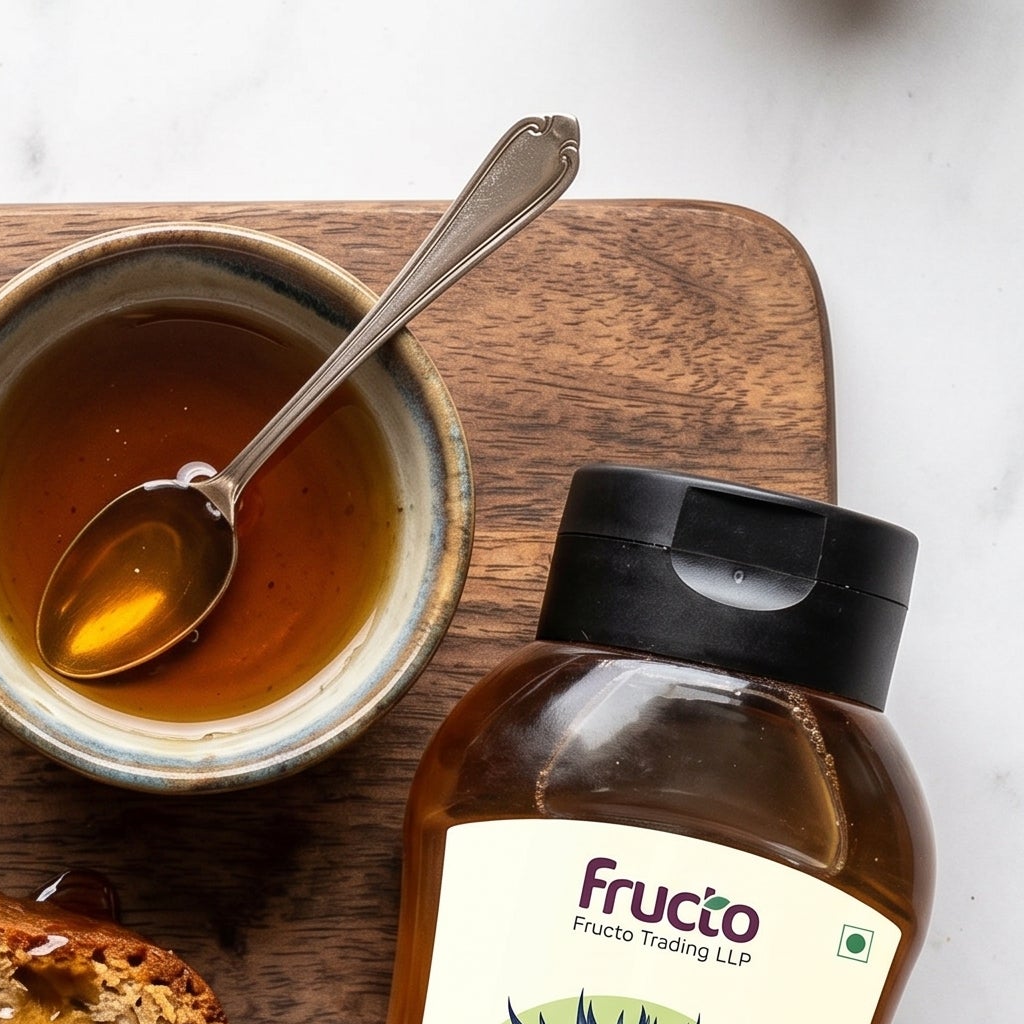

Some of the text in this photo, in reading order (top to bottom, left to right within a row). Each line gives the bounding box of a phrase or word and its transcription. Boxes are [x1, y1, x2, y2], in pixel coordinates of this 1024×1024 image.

[579, 857, 760, 943] fructo
[573, 916, 751, 966] Fructo Trading LLP
